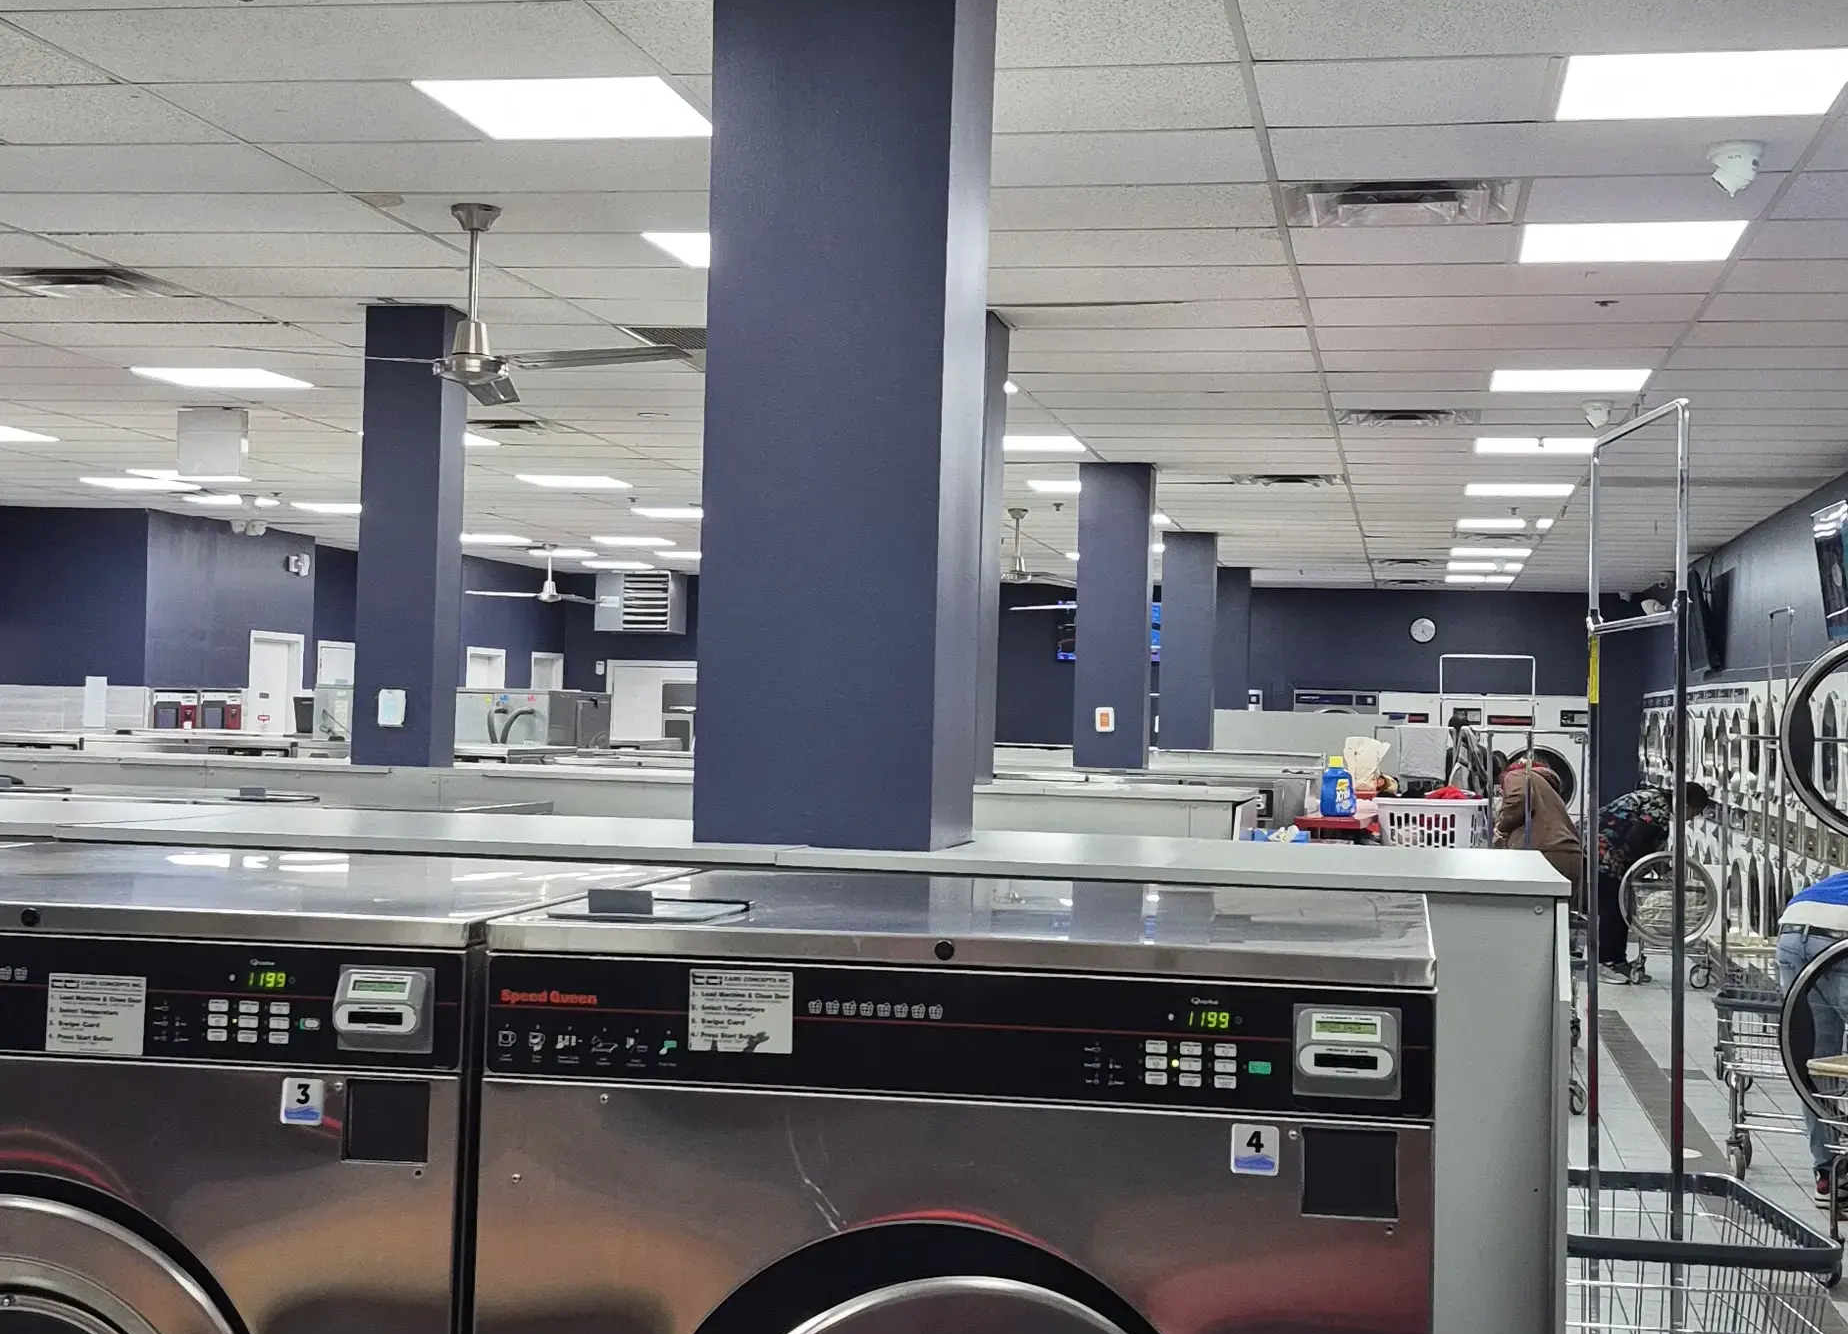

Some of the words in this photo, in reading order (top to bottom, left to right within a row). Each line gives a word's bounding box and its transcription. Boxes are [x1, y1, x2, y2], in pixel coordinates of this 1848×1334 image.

[501, 989, 548, 1004] Speed
[550, 990, 597, 1004] Queen
[1189, 1011, 1230, 1028] 1199
[296, 1083, 311, 1105] 3
[1246, 1130, 1265, 1154] 4
